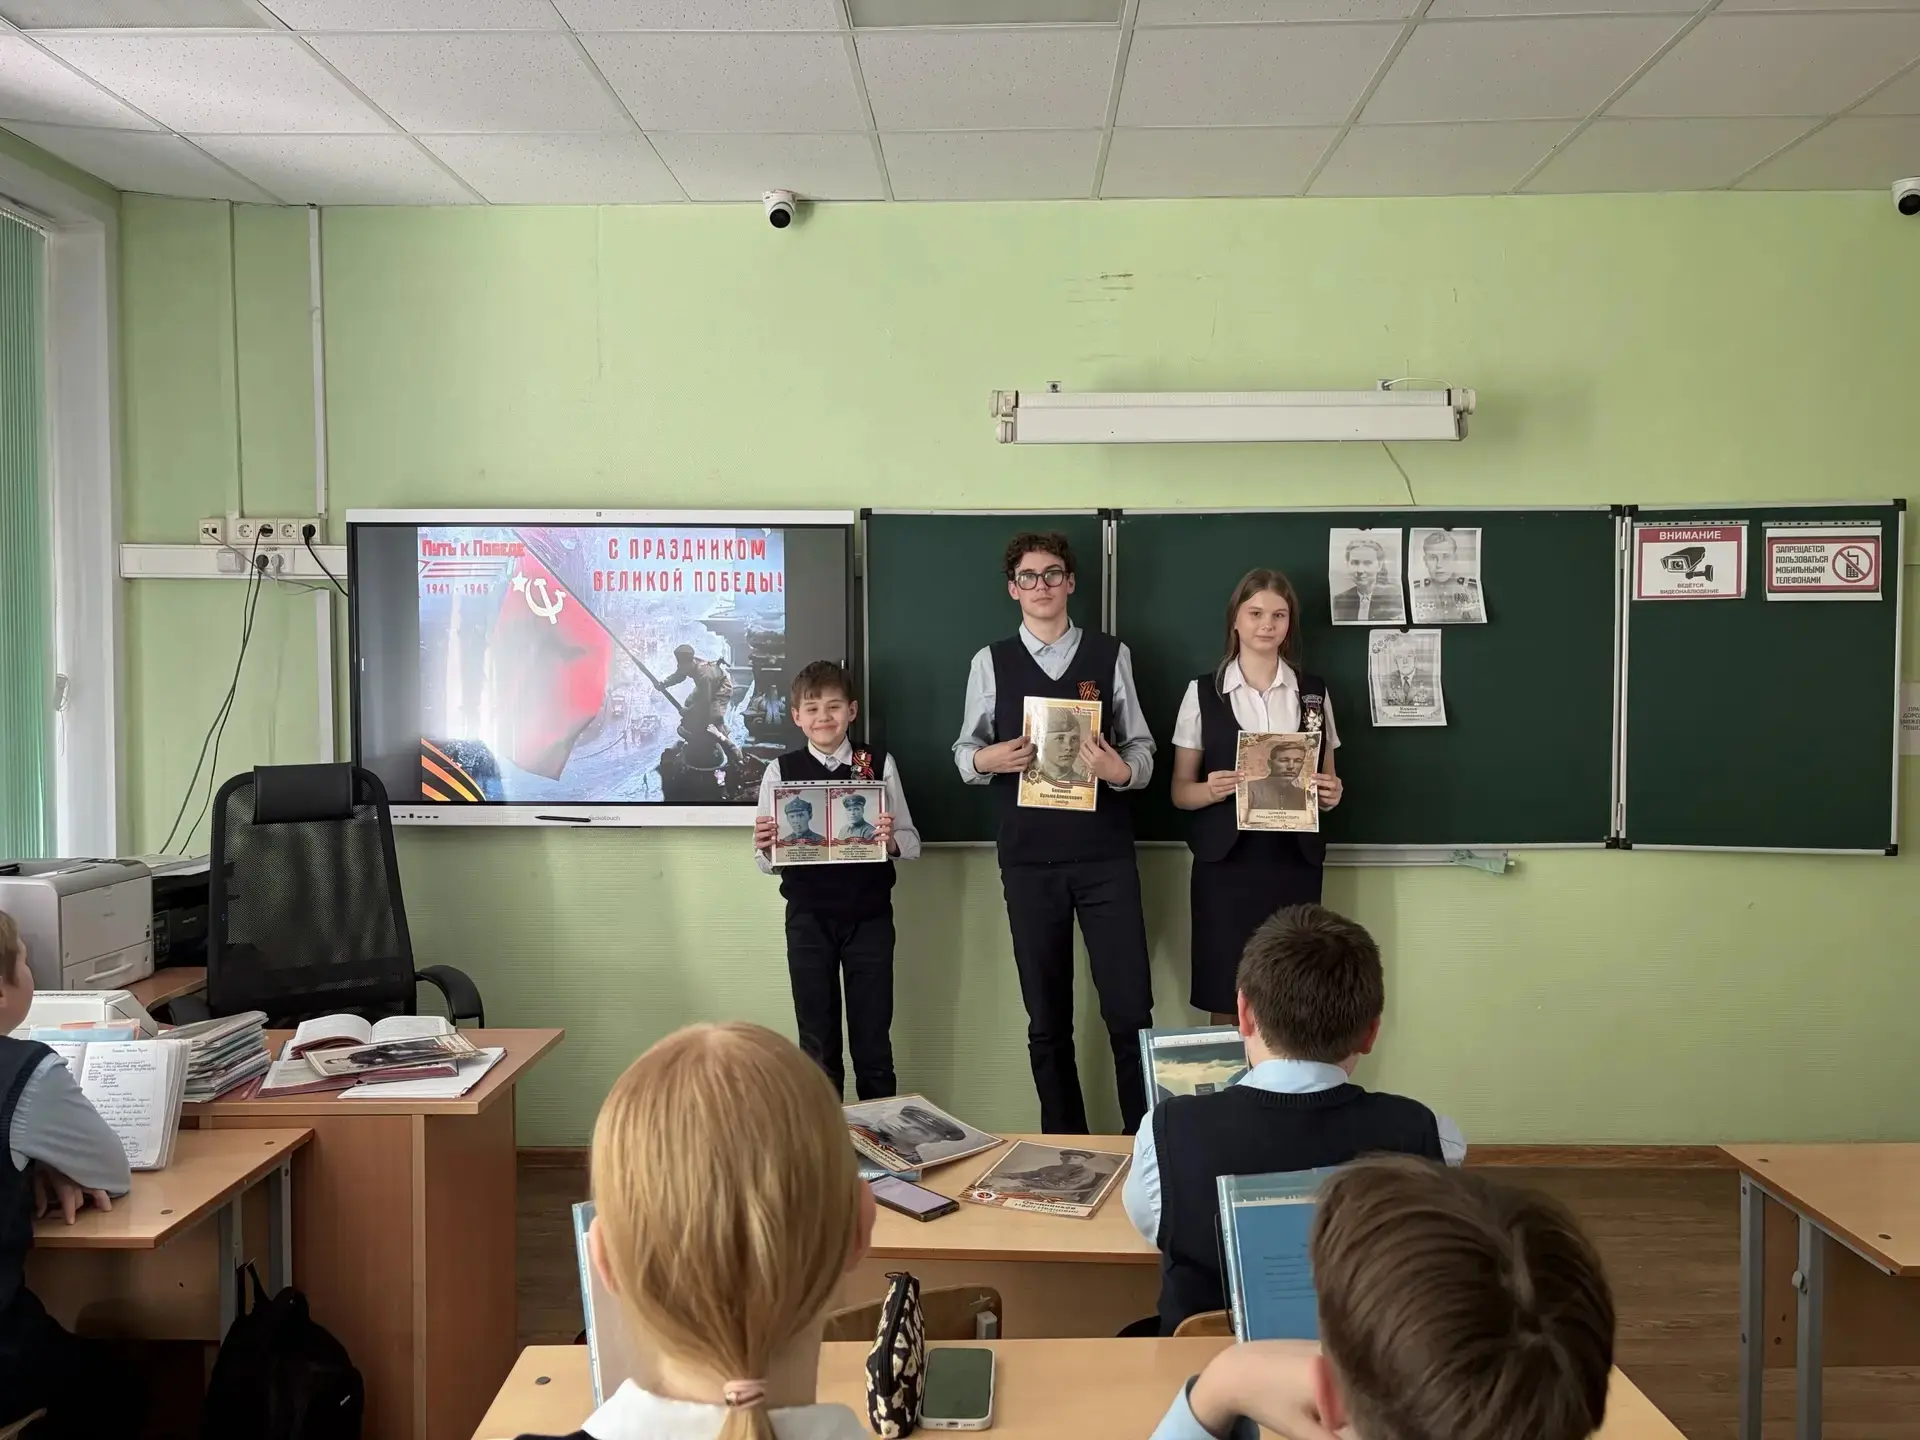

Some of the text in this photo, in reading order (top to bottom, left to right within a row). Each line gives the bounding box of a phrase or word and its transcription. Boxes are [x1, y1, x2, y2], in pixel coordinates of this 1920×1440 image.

[1660, 531, 1721, 540] ВНИМАНИЕ
[608, 538, 767, 562] С ПРАЗДНИКОМ
[1775, 545, 1825, 553] ЗАПРЕЩАЕТСЯ
[1775, 566, 1825, 574] МОБИЛЬНЫМИ
[593, 568, 783, 595] ВЕЛИКОЙ ПОБЕДЫ!
[1775, 576, 1821, 584] ТЕЛЕФОНАМИ
[425, 583, 450, 594] 1941
[464, 583, 489, 595] 1945
